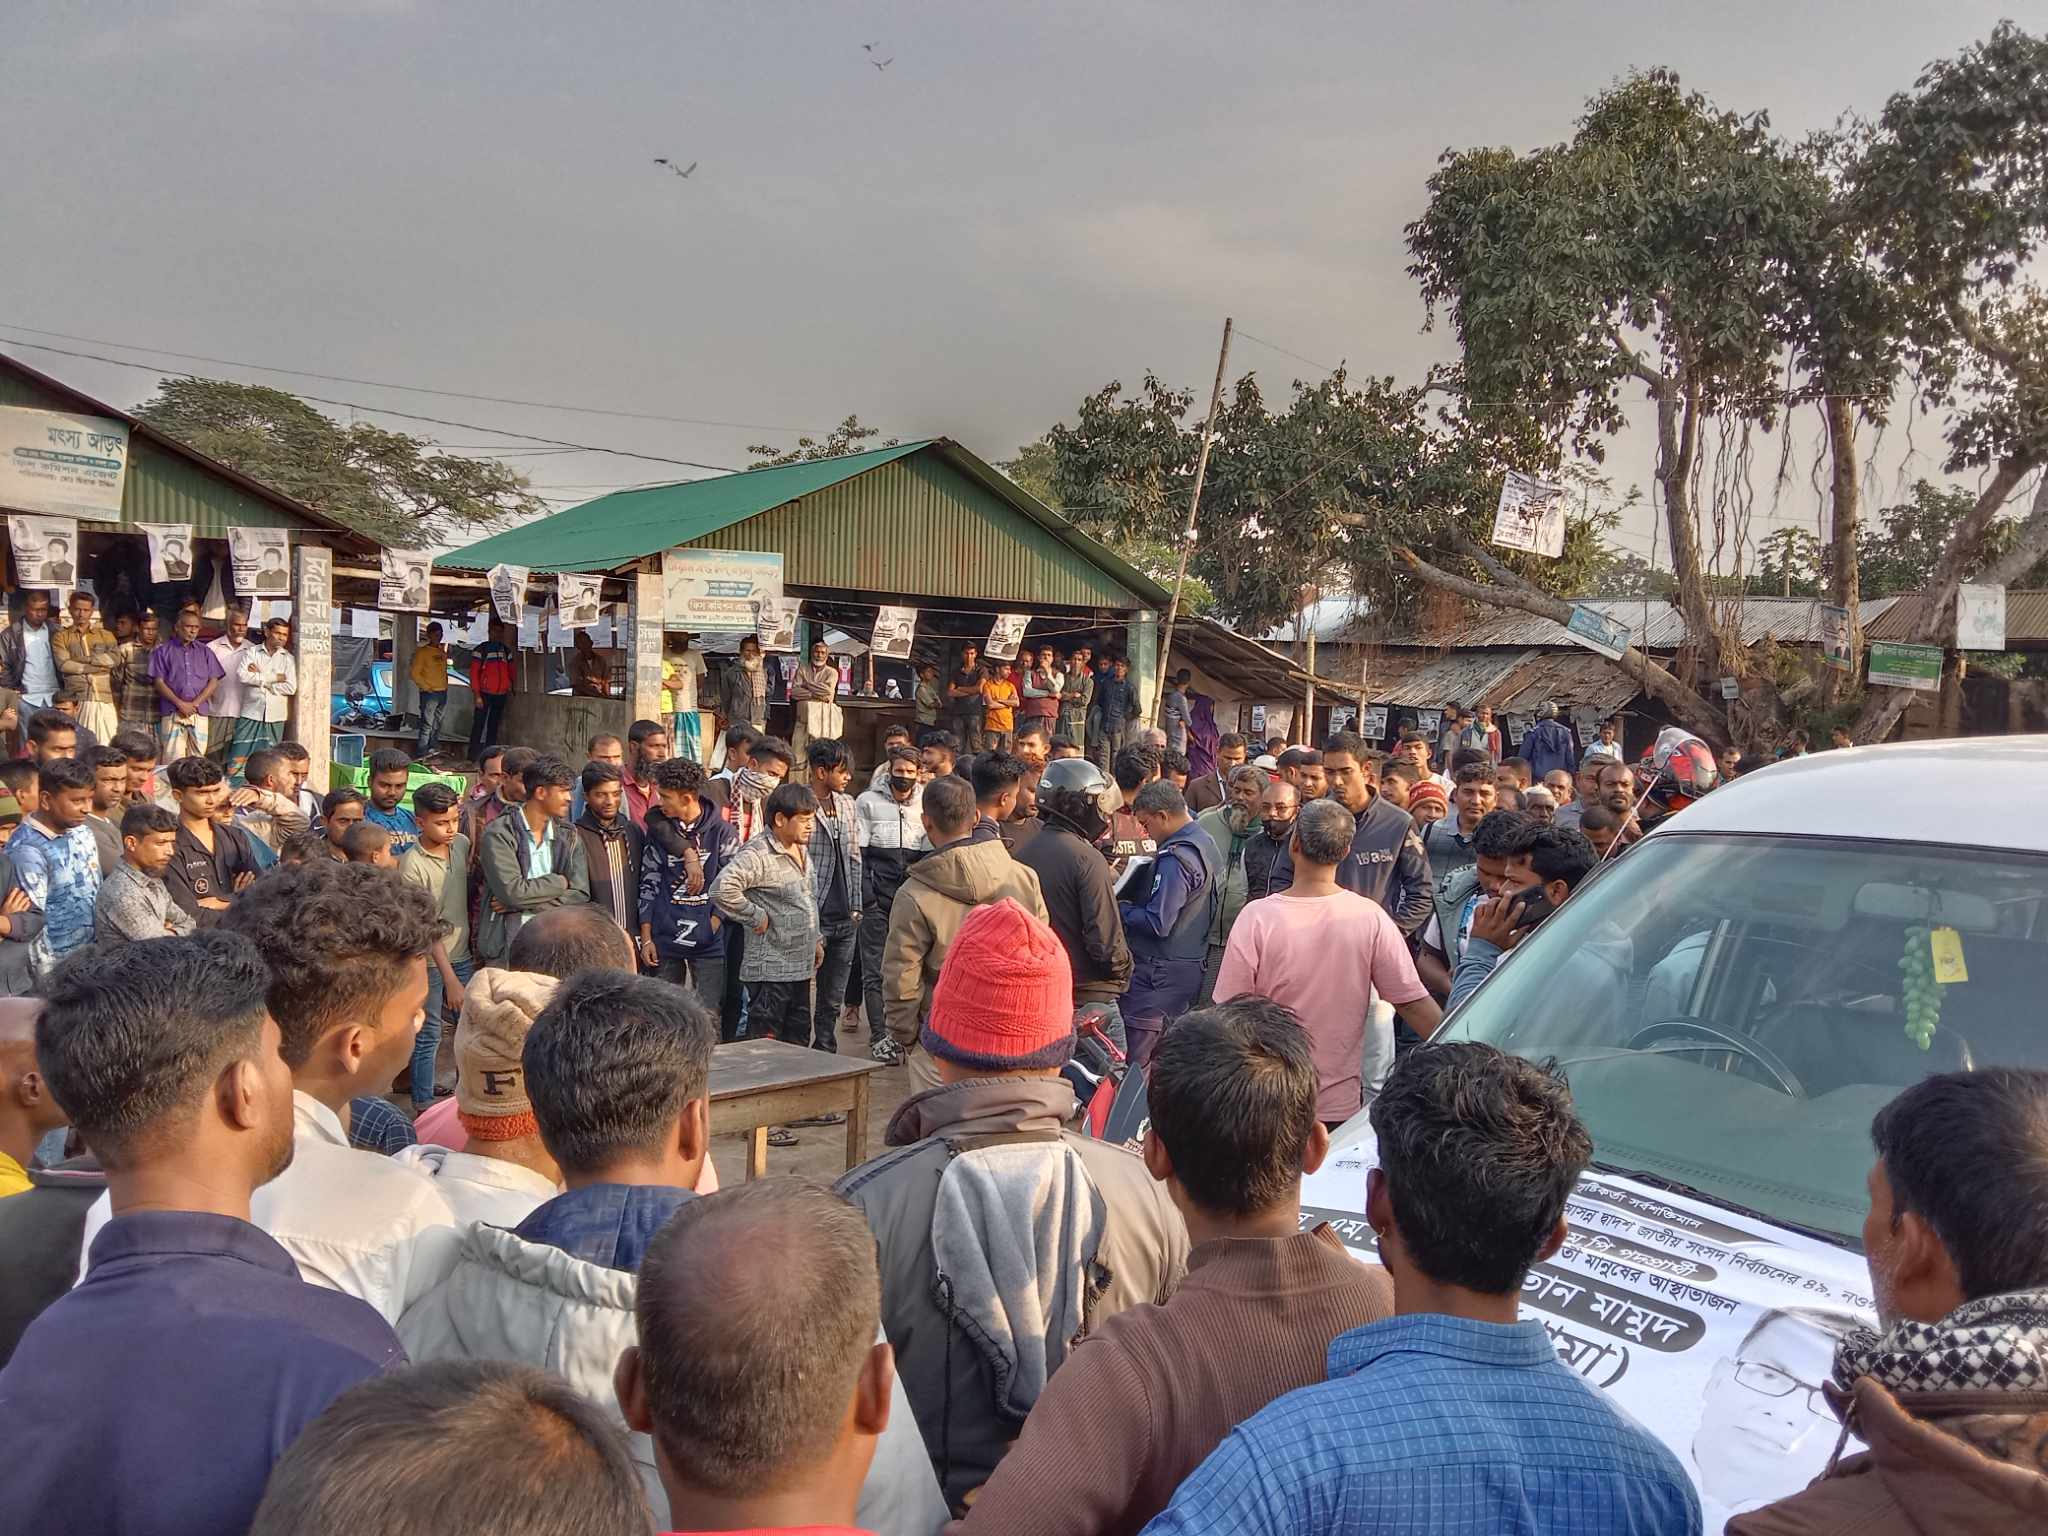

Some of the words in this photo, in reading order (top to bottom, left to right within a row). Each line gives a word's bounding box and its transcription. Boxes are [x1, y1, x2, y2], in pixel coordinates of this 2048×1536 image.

[48, 427, 82, 449] মৎস্য
[480, 1068, 522, 1095] F
[1599, 1211, 1635, 1232] দ্বাদশ
[1636, 1222, 1683, 1248] জাতীয়
[1685, 1240, 1730, 1262] সংসদ
[1728, 1251, 1803, 1287] নির্বাচনের
[1520, 1269, 1587, 1309] তান
[1589, 1290, 1690, 1343] মামুদ
[1584, 1253, 1646, 1284] মানুষের
[1648, 1272, 1742, 1316] আস্থাভাজন
